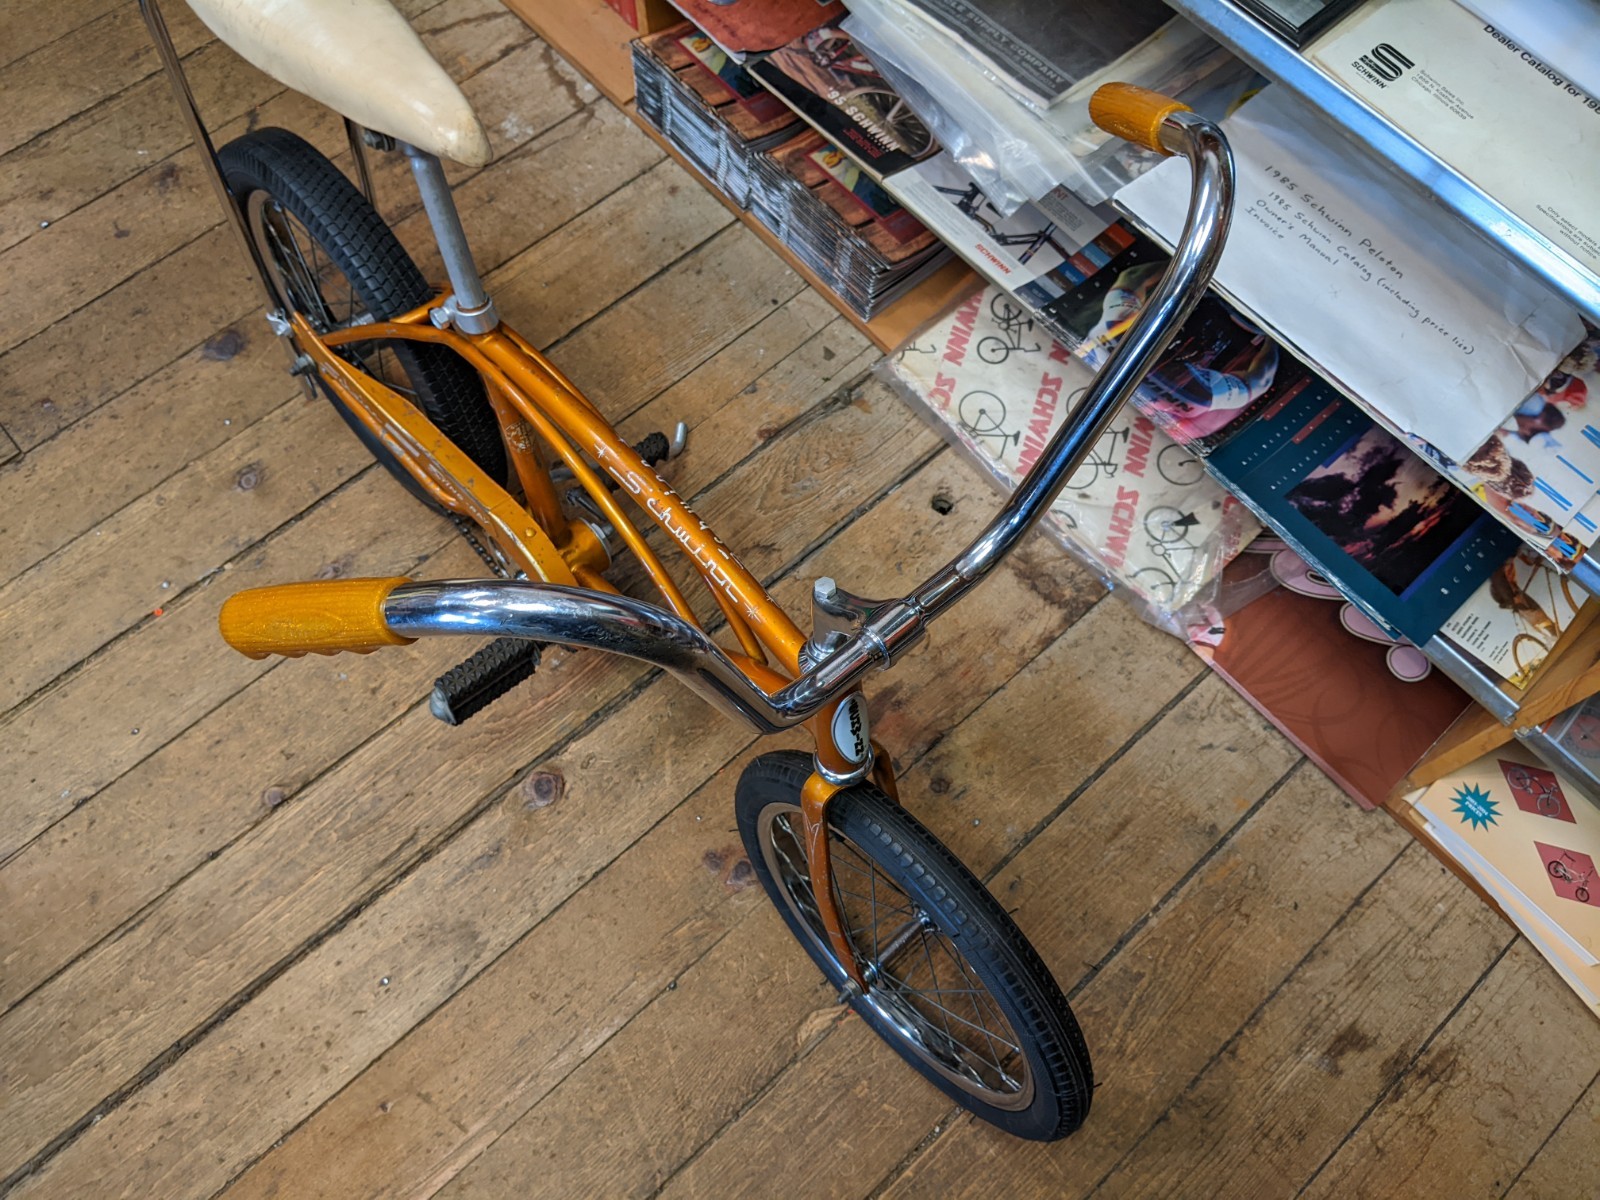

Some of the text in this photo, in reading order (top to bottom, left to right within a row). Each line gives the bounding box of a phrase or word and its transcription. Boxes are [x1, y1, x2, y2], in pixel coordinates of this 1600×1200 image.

[966, 11, 1010, 43] SUPPLY
[1010, 43, 1065, 84] COMPANY
[1483, 24, 1521, 53] Dealer
[1520, 52, 1563, 86] Catalog
[1563, 83, 1582, 97] for
[1351, 61, 1388, 89] SCHWINN
[1420, 69, 1441, 88] Schwinn
[1440, 86, 1456, 99] Sales
[1432, 91, 1449, 108] Illinois
[1455, 103, 1474, 120] Avenue
[845, 105, 900, 152] SCHWINN
[1245, 206, 1285, 240] Invoice
[1256, 198, 1340, 266] Owner's Manual
[1264, 165, 1404, 280] 1985 Schwinn Peloton
[1536, 204, 1573, 234] Specifications
[1572, 233, 1583, 241] are
[1547, 206, 1597, 246] Only select models
[1559, 230, 1580, 246] without
[975, 243, 1012, 275] SCHWINN
[1268, 191, 1475, 355] 1985 Schwinn Catalog (including price list)
[609, 465, 739, 604] Schwinn
